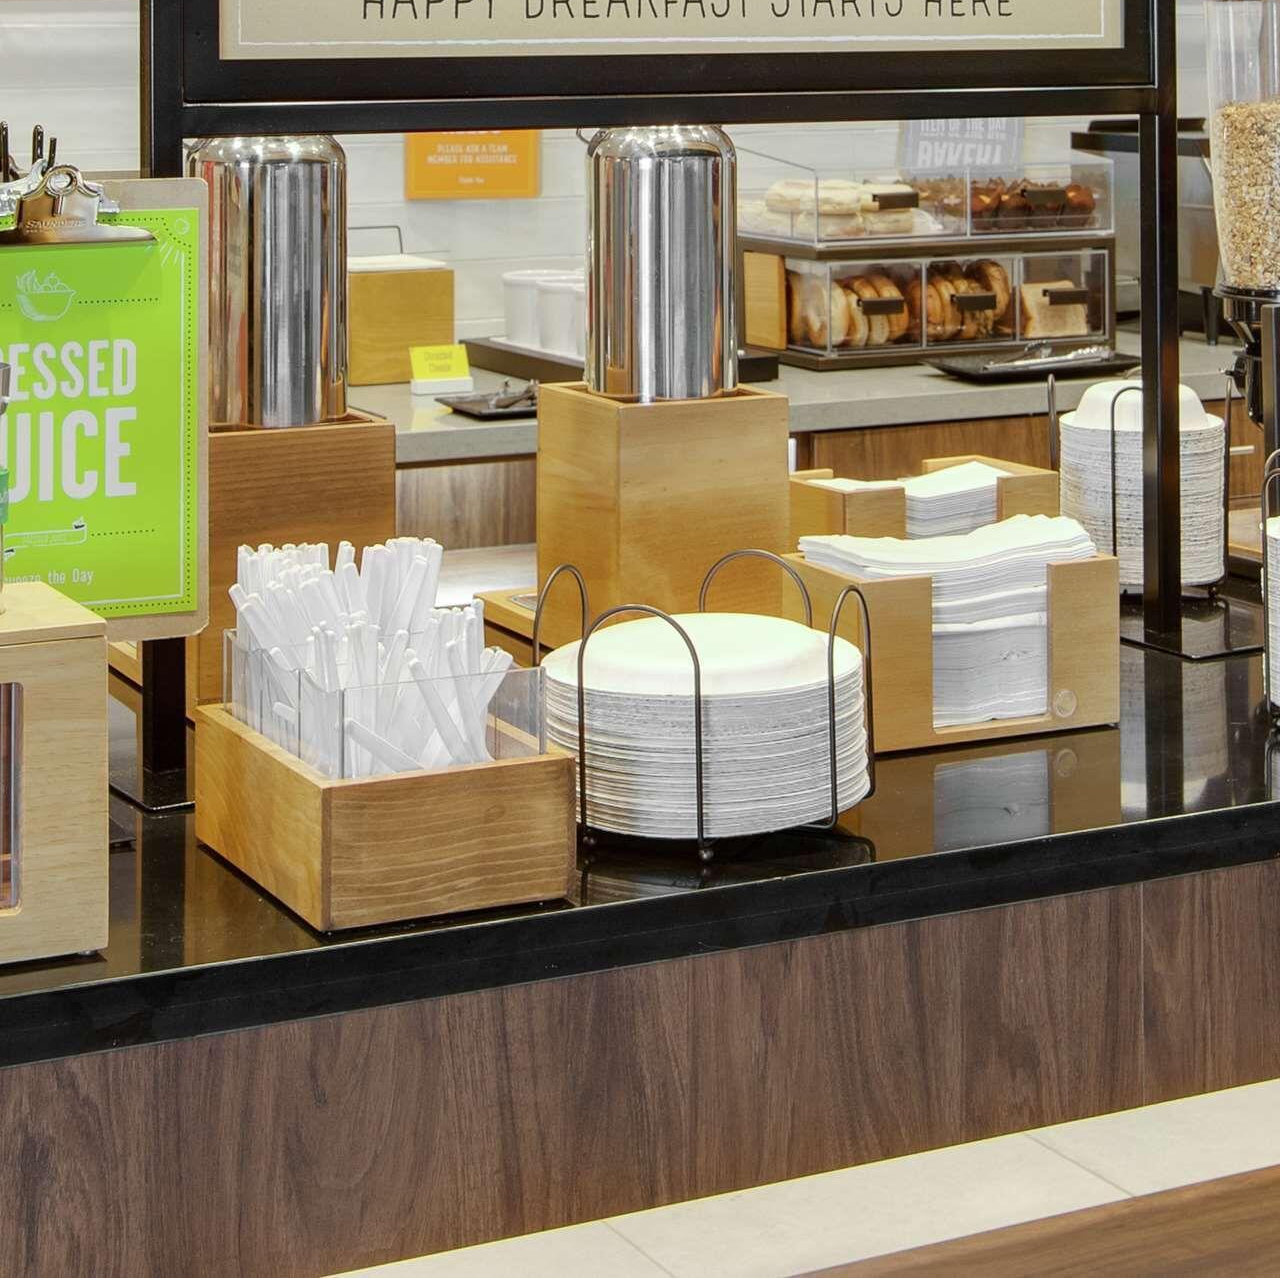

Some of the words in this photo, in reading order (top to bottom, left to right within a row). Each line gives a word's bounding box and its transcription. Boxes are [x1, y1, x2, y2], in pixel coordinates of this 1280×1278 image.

[1, 406, 137, 503] UICE
[48, 568, 65, 585] the
[72, 567, 94, 585] Day
